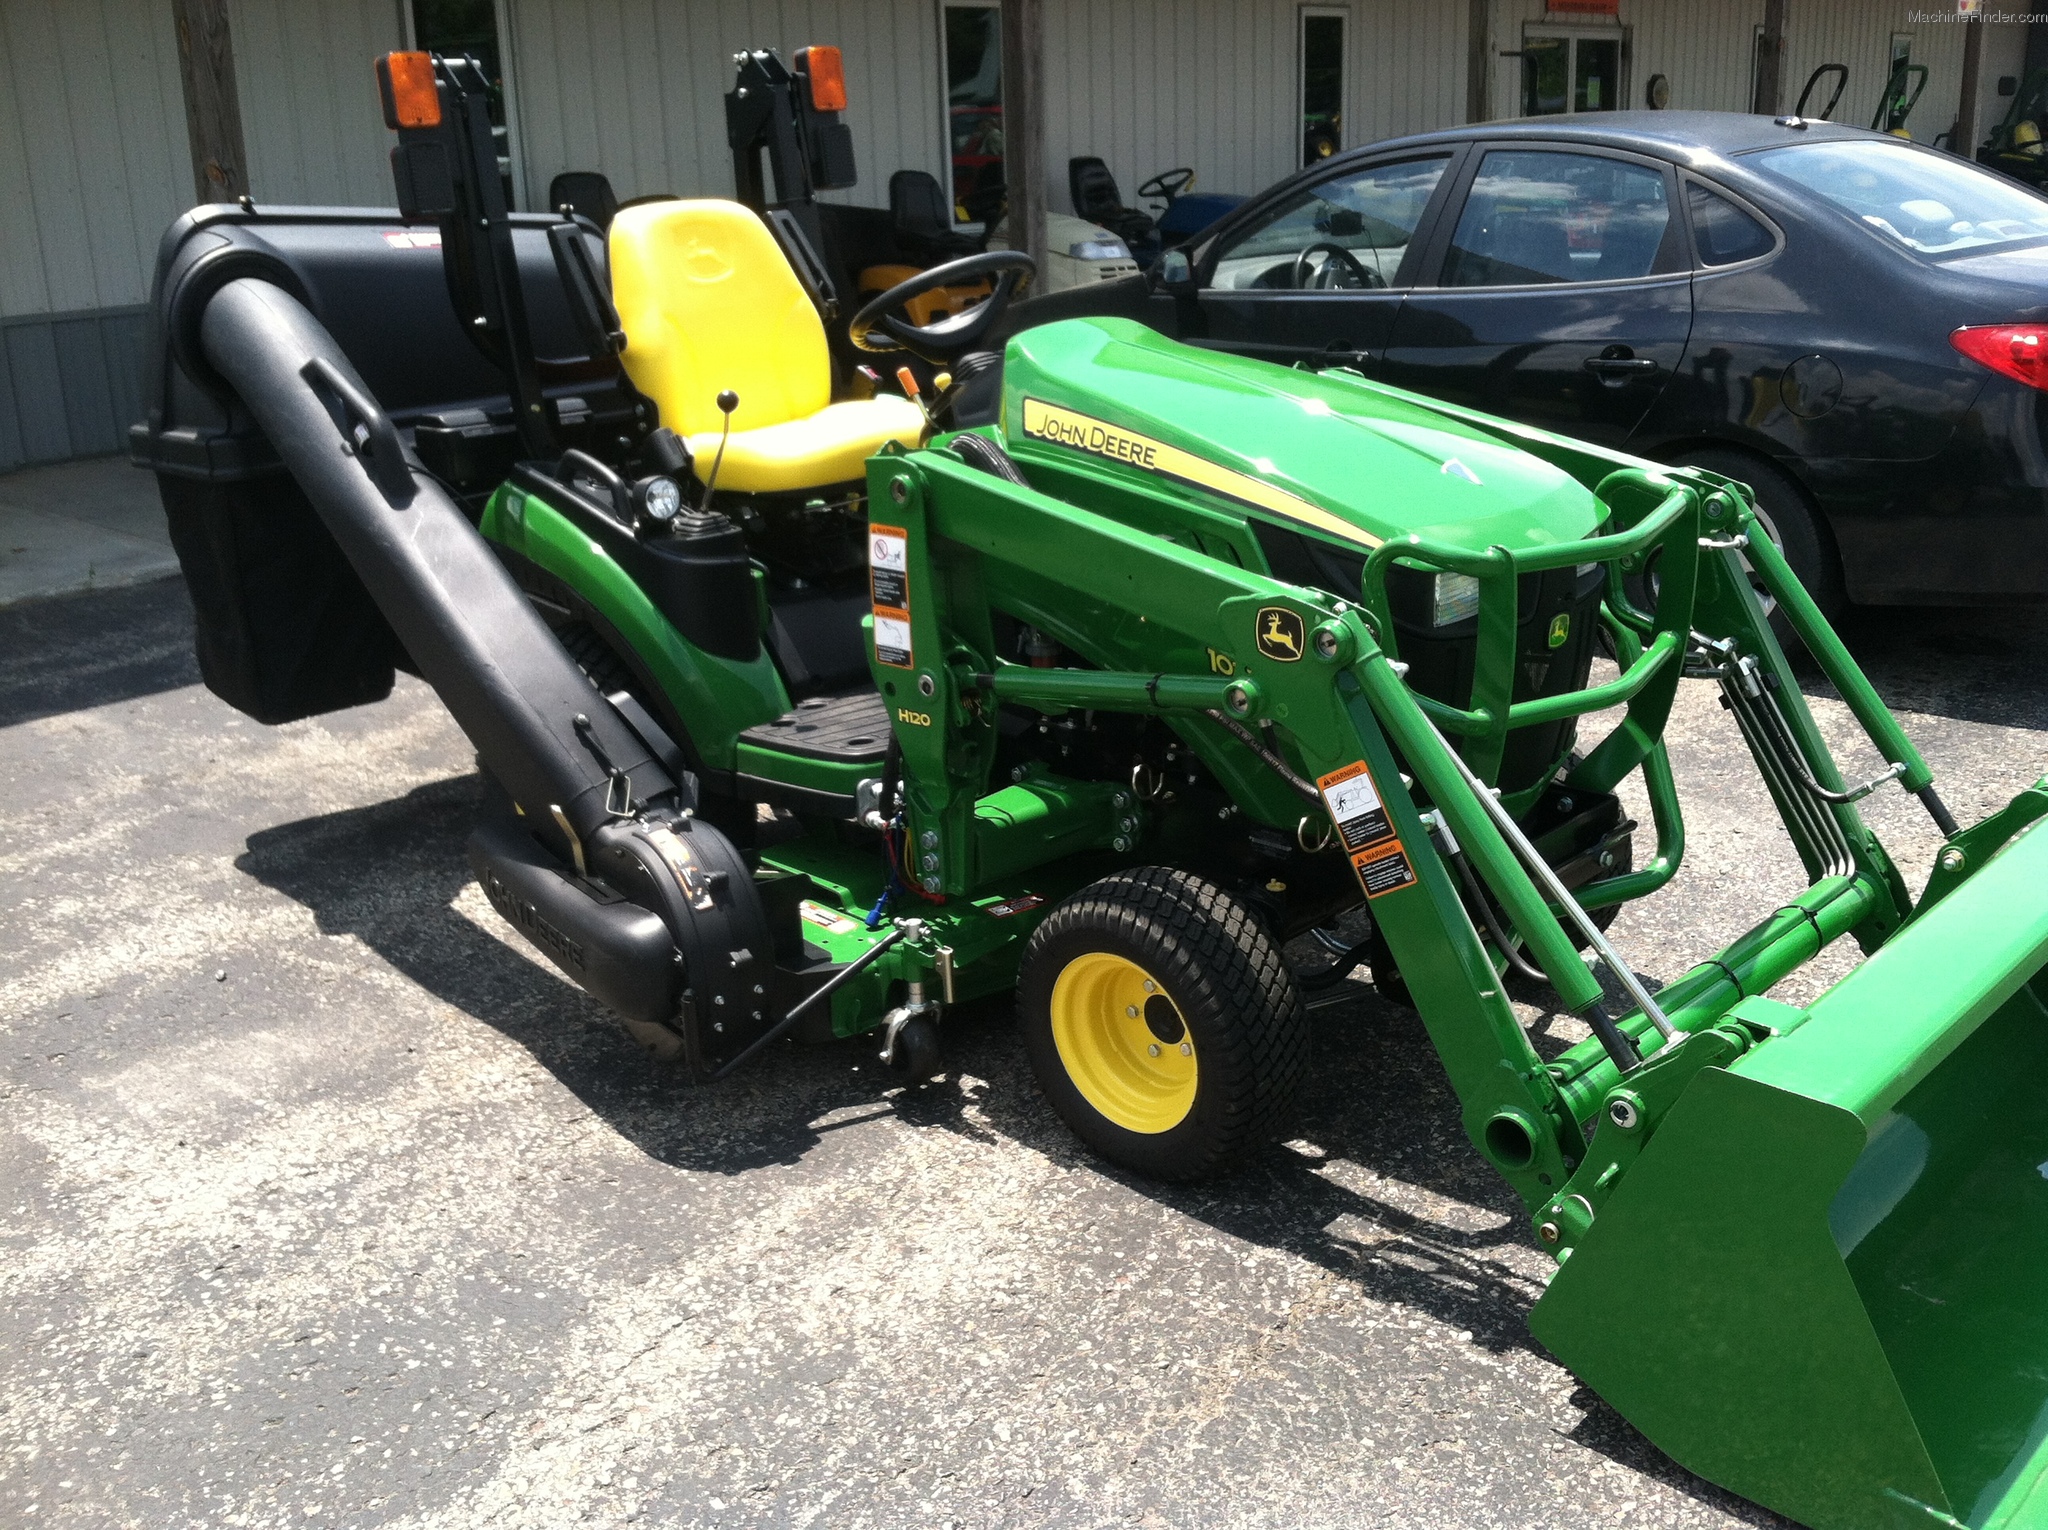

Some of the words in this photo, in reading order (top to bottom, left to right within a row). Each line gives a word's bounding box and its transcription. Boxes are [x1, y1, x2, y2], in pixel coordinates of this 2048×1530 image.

[1036, 414, 1087, 445] JOHN
[1089, 426, 1157, 467] DEERE
[1207, 647, 1236, 675] 10
[898, 706, 931, 727] H120
[1330, 765, 1361, 783] WARNING
[1364, 844, 1397, 861] WARNING
